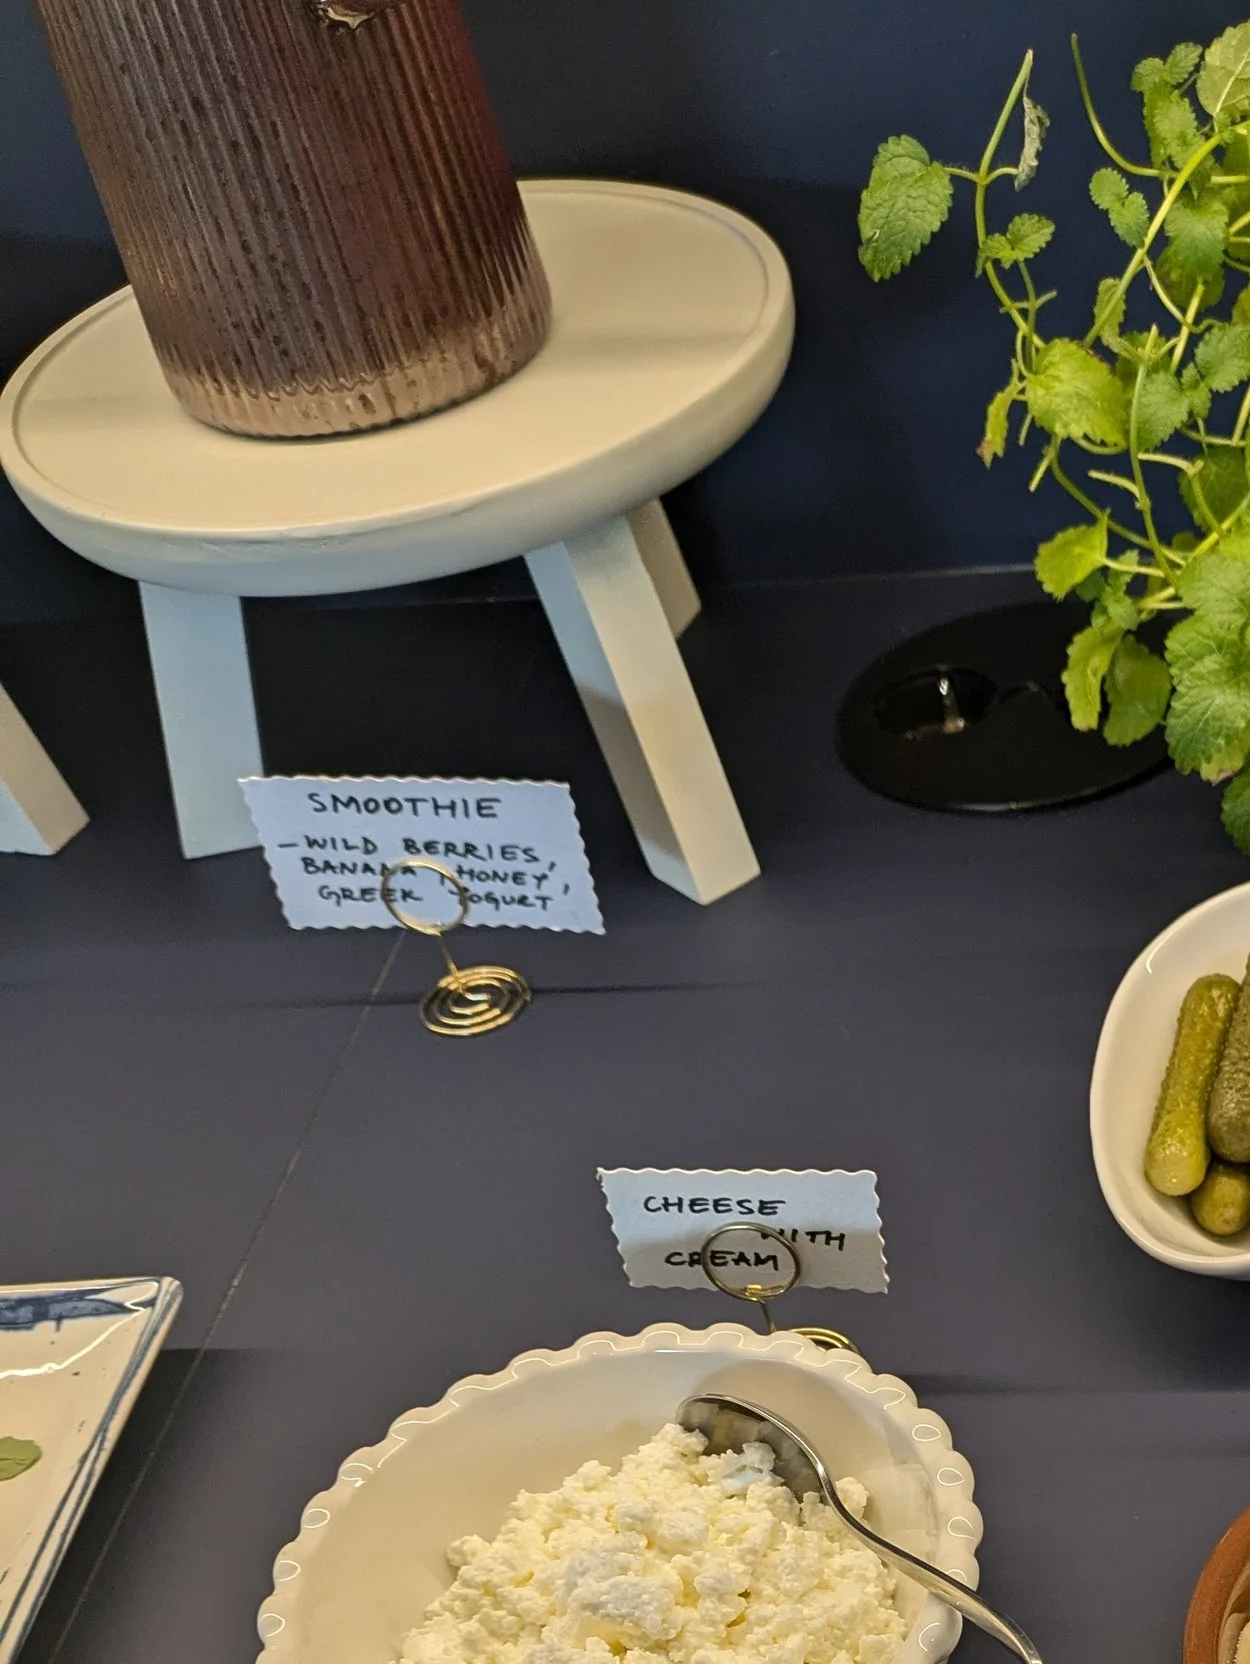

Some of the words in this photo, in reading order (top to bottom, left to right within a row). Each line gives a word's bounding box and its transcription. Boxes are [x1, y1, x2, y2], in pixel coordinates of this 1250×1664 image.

[307, 792, 503, 820] SMOOTHIE
[643, 1195, 786, 1217] CHEESE
[664, 1250, 780, 1272] CREAM
